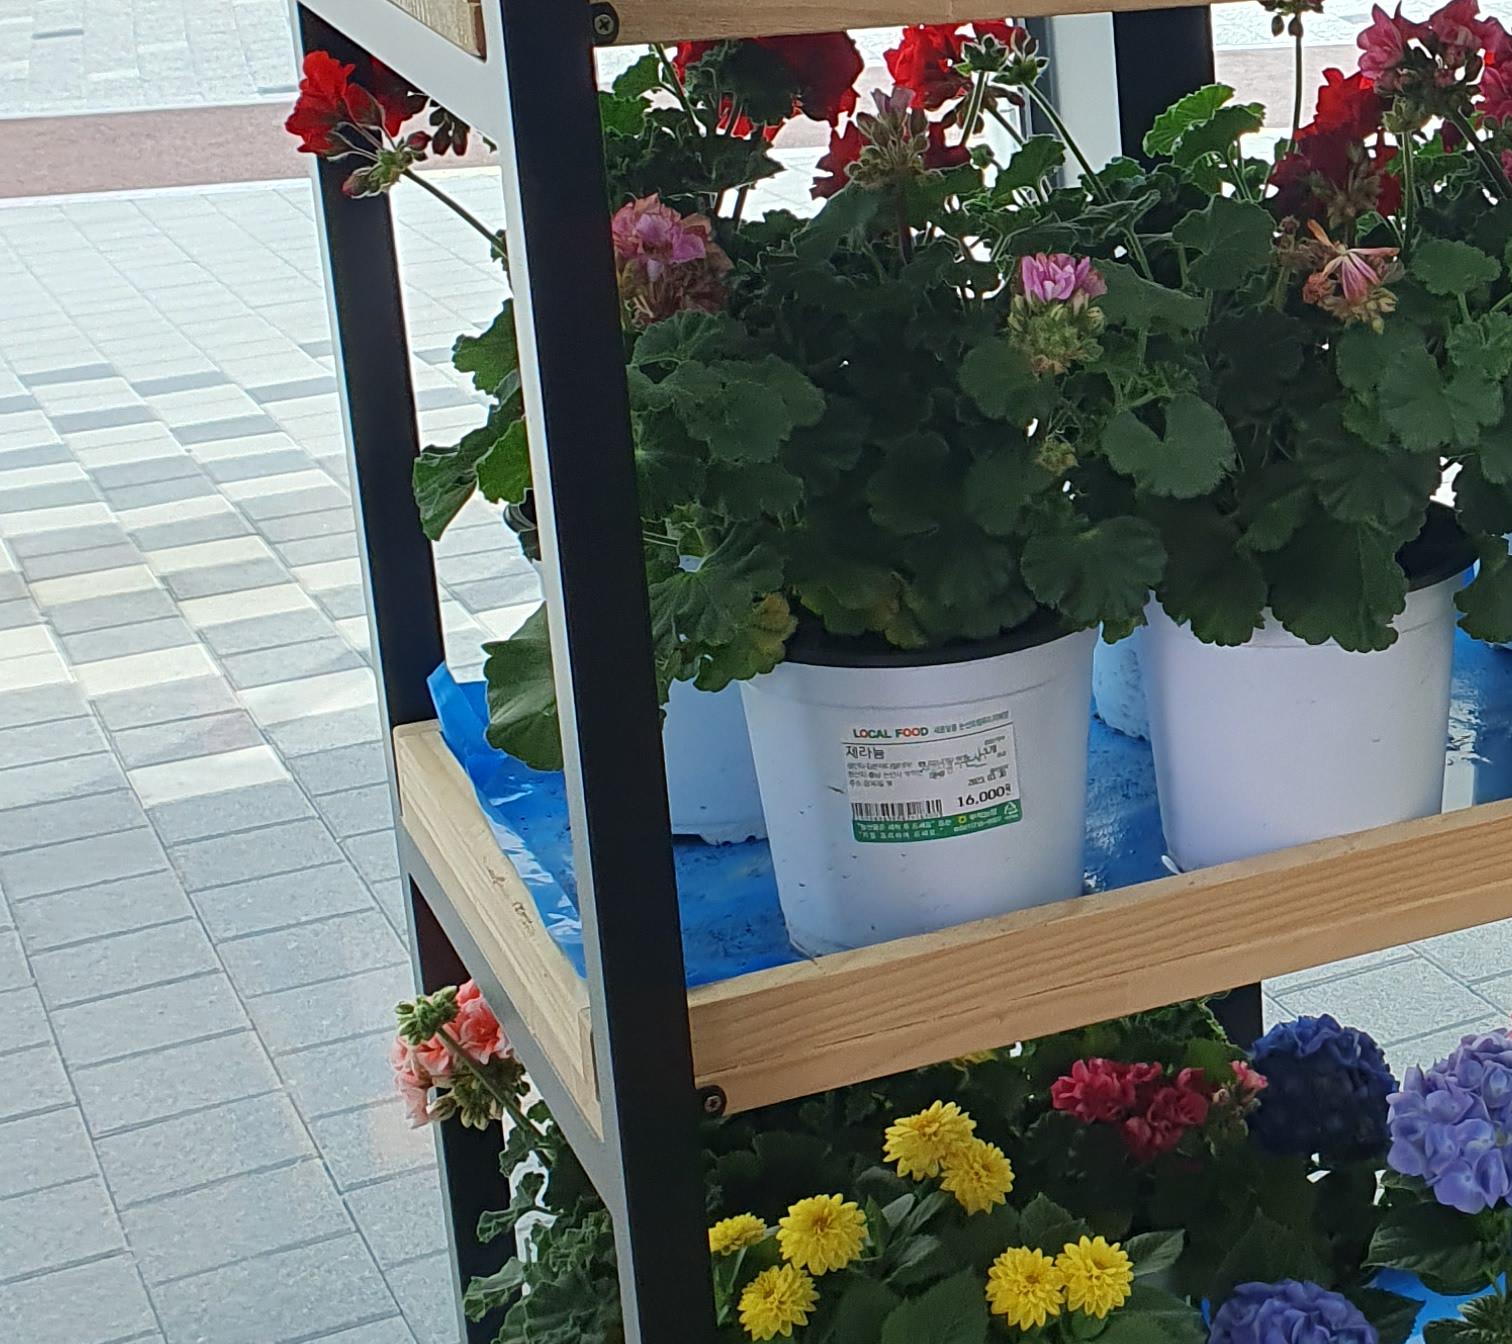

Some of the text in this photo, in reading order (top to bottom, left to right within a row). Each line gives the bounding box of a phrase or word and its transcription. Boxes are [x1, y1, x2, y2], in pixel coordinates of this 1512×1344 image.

[853, 728, 892, 739] LOCAL
[895, 727, 929, 738] FOOD
[846, 746, 885, 760] 제라늄
